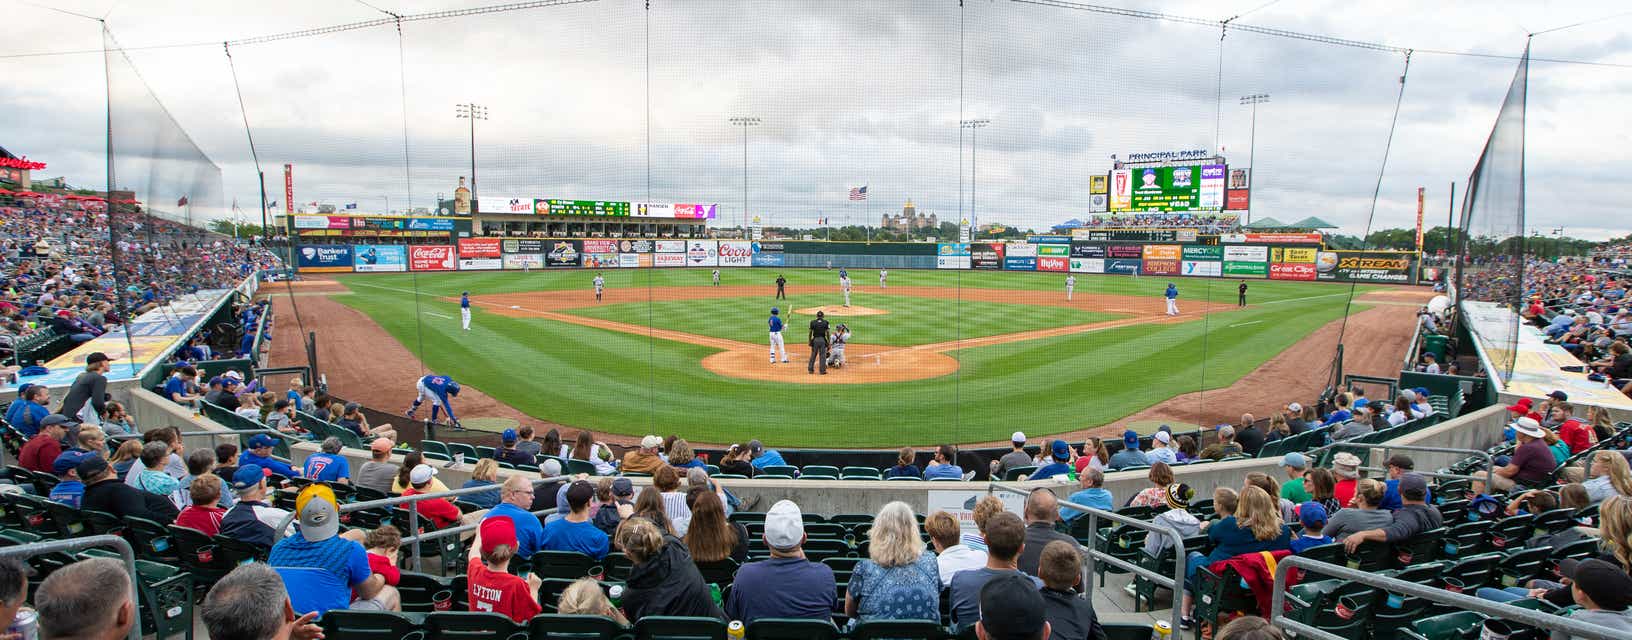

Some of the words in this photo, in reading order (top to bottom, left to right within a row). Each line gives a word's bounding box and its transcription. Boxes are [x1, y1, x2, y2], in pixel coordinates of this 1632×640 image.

[1129, 151, 1178, 160] PRINCIPAL
[1180, 149, 1208, 158] PARK
[317, 247, 347, 256] Bankers
[414, 248, 446, 259] Coca-Cola
[719, 243, 751, 257] Coors
[1270, 264, 1293, 273] Great
[1294, 265, 1314, 274] Clips
[1338, 257, 1410, 270] XTREAM
[306, 462, 327, 480] 17
[473, 584, 503, 602] LYTTON
